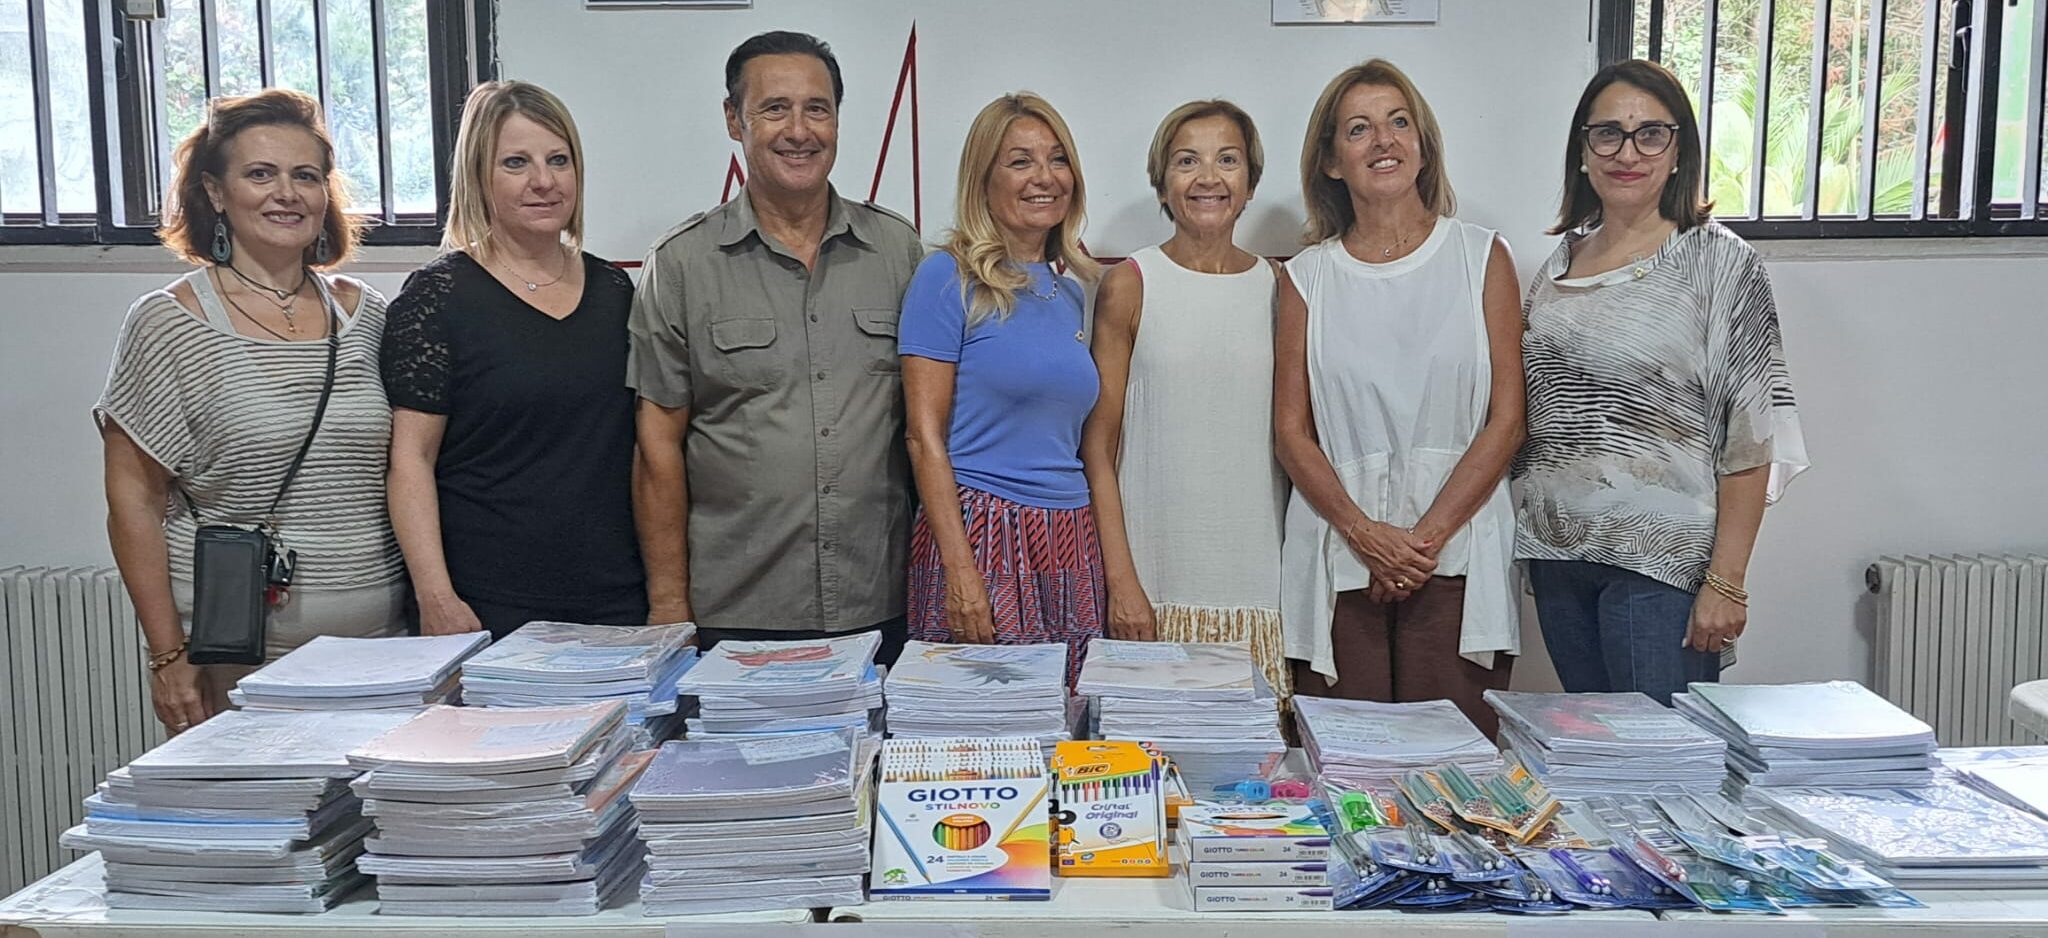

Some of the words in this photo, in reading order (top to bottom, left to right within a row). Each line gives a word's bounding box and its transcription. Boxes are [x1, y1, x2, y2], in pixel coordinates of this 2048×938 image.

[908, 786, 1018, 802] GIOTTO
[925, 802, 1001, 811] STILNOVO
[1091, 803, 1130, 811] Cristal
[926, 855, 944, 864] 24
